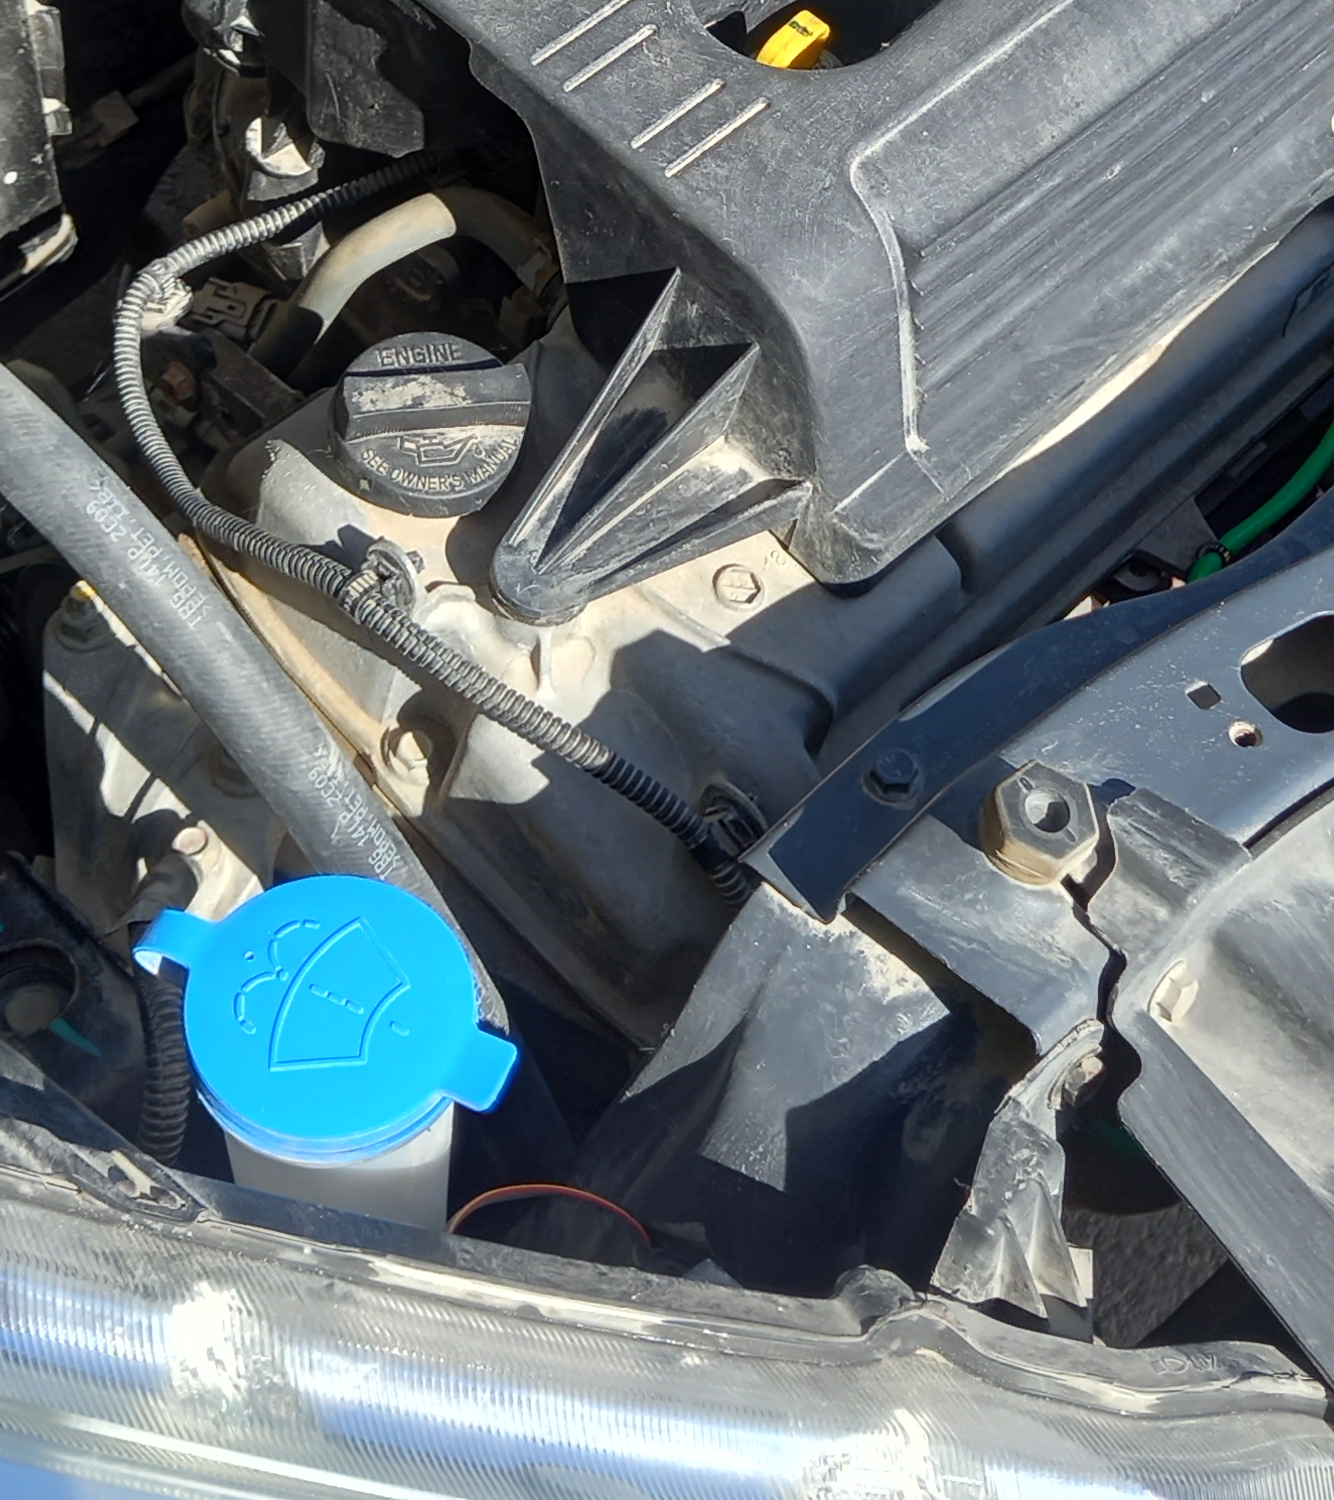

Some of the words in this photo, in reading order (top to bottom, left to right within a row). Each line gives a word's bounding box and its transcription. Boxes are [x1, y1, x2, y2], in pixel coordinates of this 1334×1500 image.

[376, 342, 463, 367] ENGINE
[361, 448, 391, 476] SEE
[391, 467, 463, 492] OWNER'S
[465, 438, 517, 484] MANUAL
